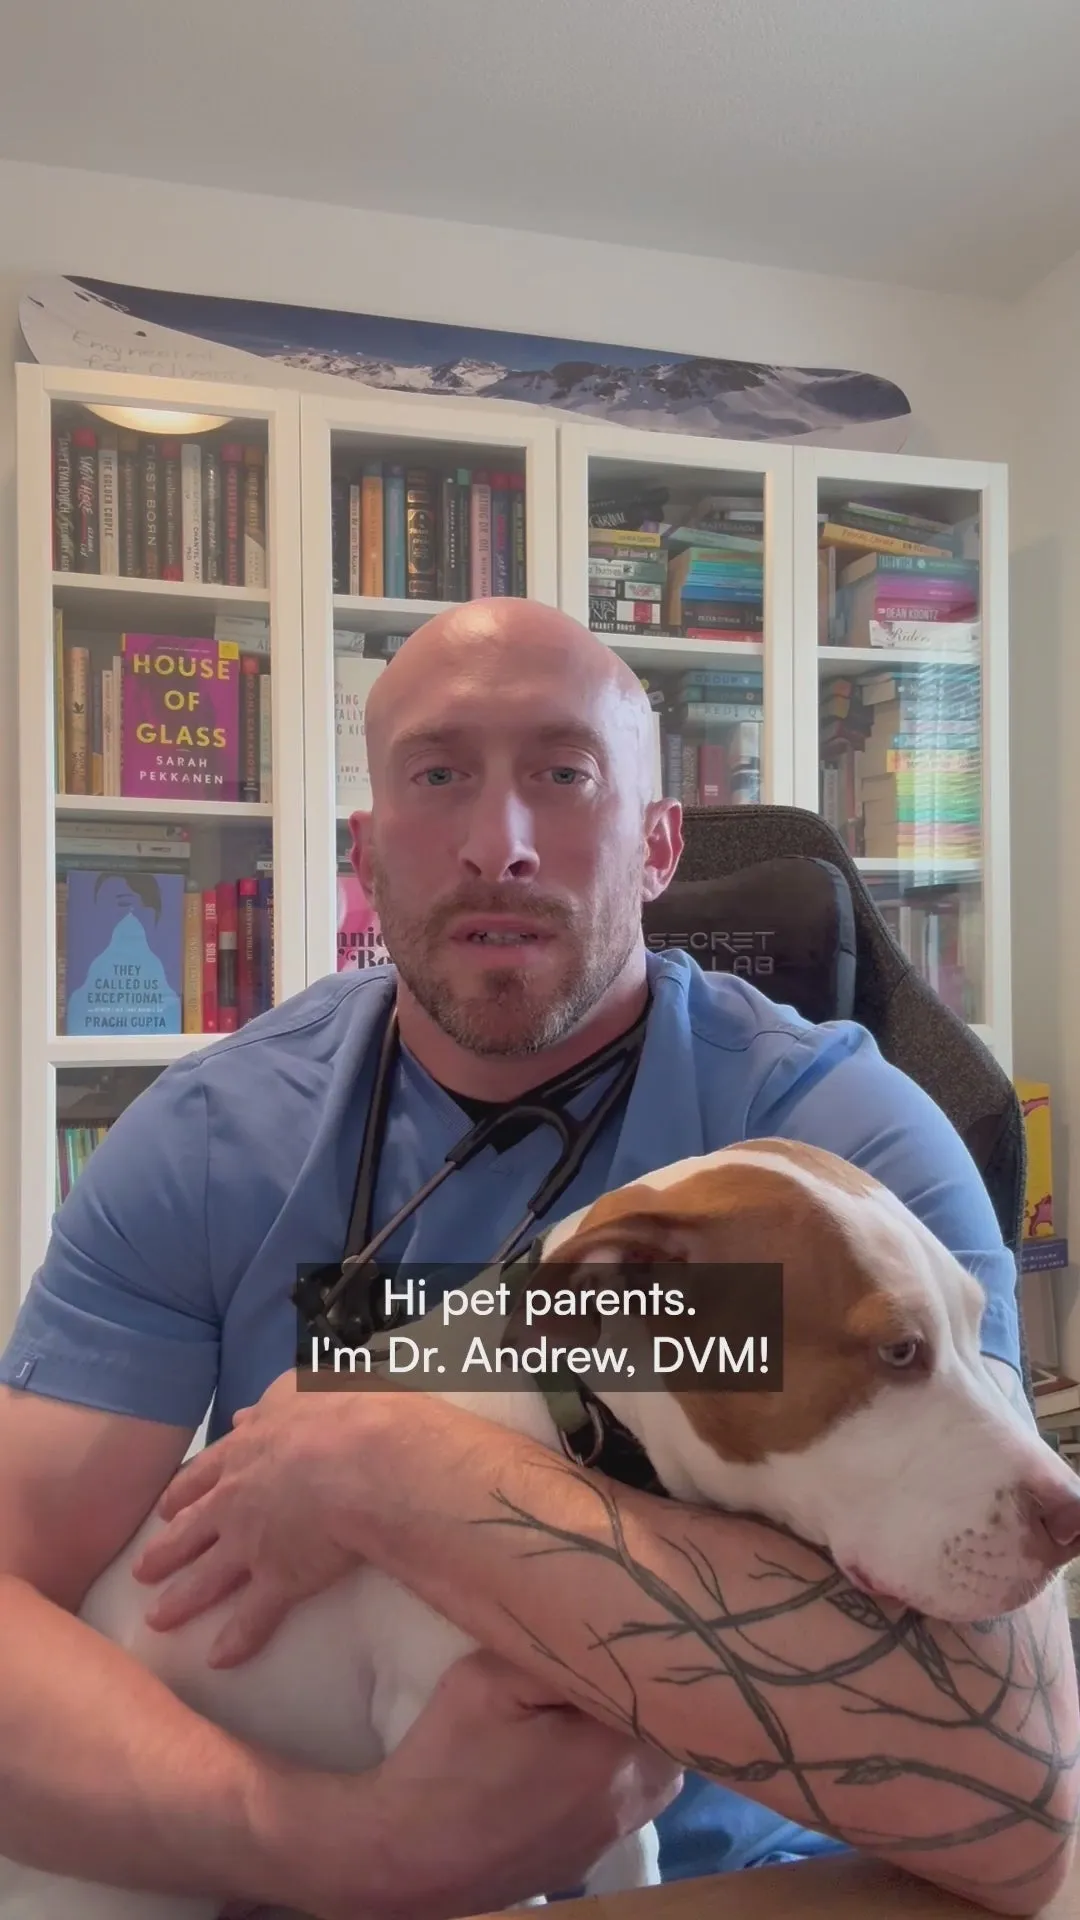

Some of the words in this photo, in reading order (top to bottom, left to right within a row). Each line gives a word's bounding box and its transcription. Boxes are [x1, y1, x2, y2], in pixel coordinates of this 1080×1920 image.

[102, 456, 113, 471] THE
[145, 443, 156, 493] FIRST
[57, 466, 72, 513] EVANOVICH
[102, 473, 114, 505] GOLDEN
[103, 507, 114, 539] COUPLE
[886, 607, 907, 619] DEAN
[908, 608, 939, 620] KOONTZ
[132, 653, 230, 680] HOUSE
[164, 690, 200, 711] OF
[247, 692, 256, 713] ONE
[135, 723, 227, 748] GLASS
[247, 717, 256, 741] CAN
[156, 755, 208, 768] SARAH
[247, 744, 256, 776] KNOW
[139, 770, 224, 785] PEKKANEN
[205, 902, 216, 921] SELL
[648, 931, 776, 953] SECRET
[205, 942, 217, 964] SOLD
[113, 964, 141, 977] THEY
[711, 956, 774, 975] LAB
[95, 979, 140, 990] CALLED
[143, 979, 159, 991] US
[87, 993, 165, 1004] EXCEPTIONAL
[84, 1016, 128, 1028] PRACHI
[131, 1016, 166, 1028] GUPTA
